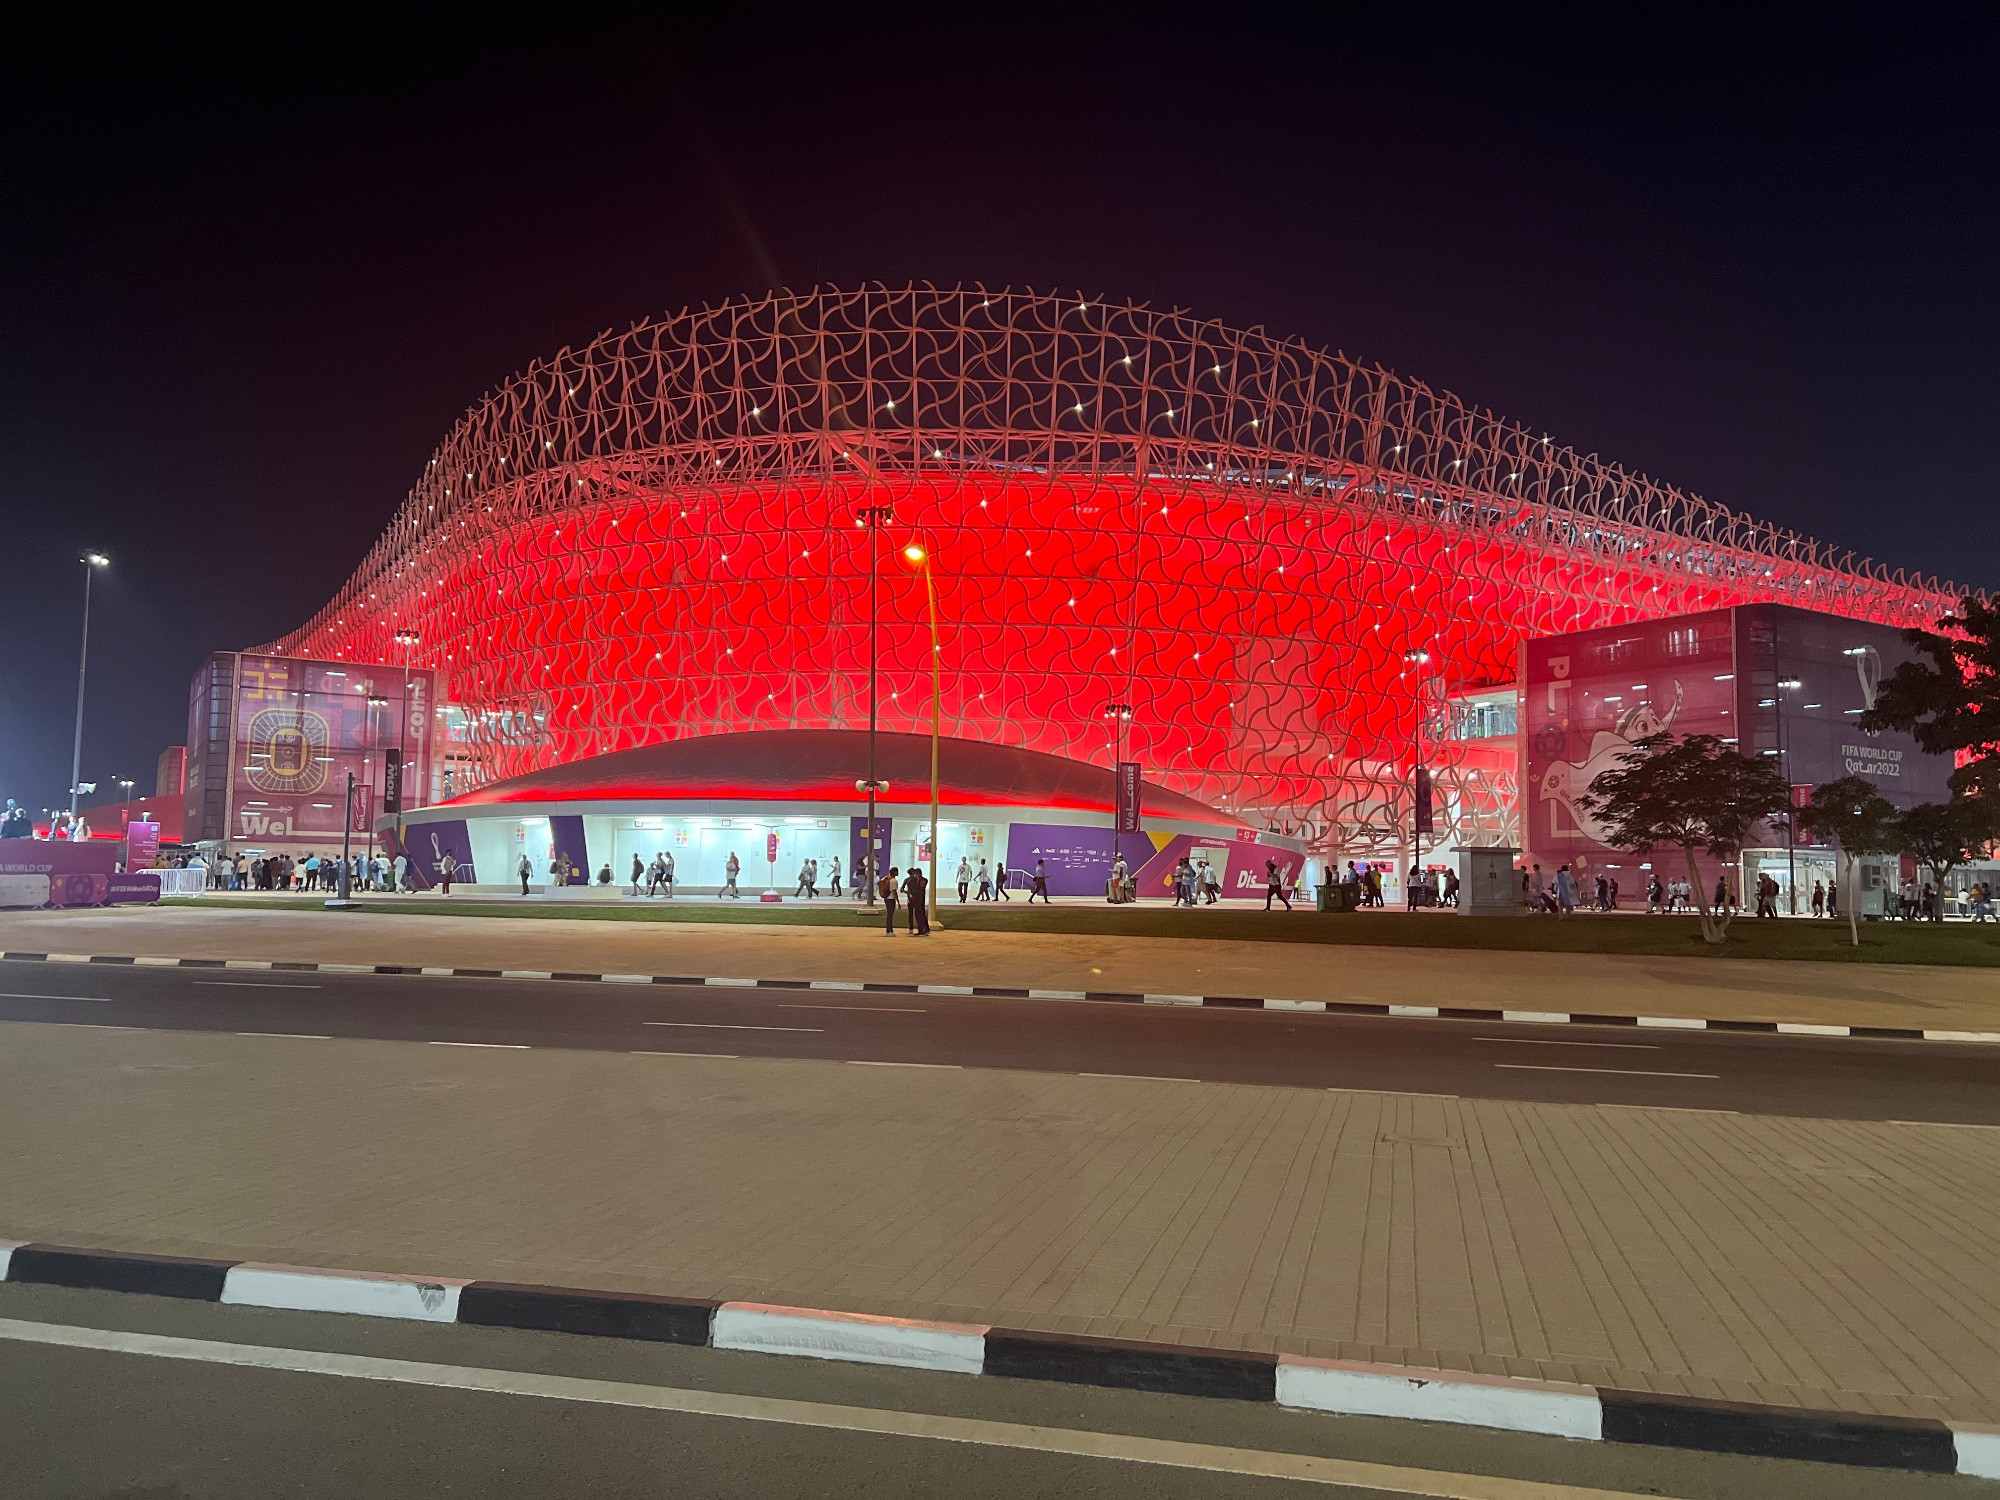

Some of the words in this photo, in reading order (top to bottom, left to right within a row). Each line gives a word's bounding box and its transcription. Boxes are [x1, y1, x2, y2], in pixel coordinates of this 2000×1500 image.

[1842, 744, 1859, 757] FIFA
[1859, 746, 1887, 760] WORLD
[1888, 750, 1903, 761] CUP
[1876, 762, 1900, 776] 2022
[1243, 830, 1250, 839] 13
[5, 864, 35, 872] WORLD
[36, 864, 53, 872] CUP
